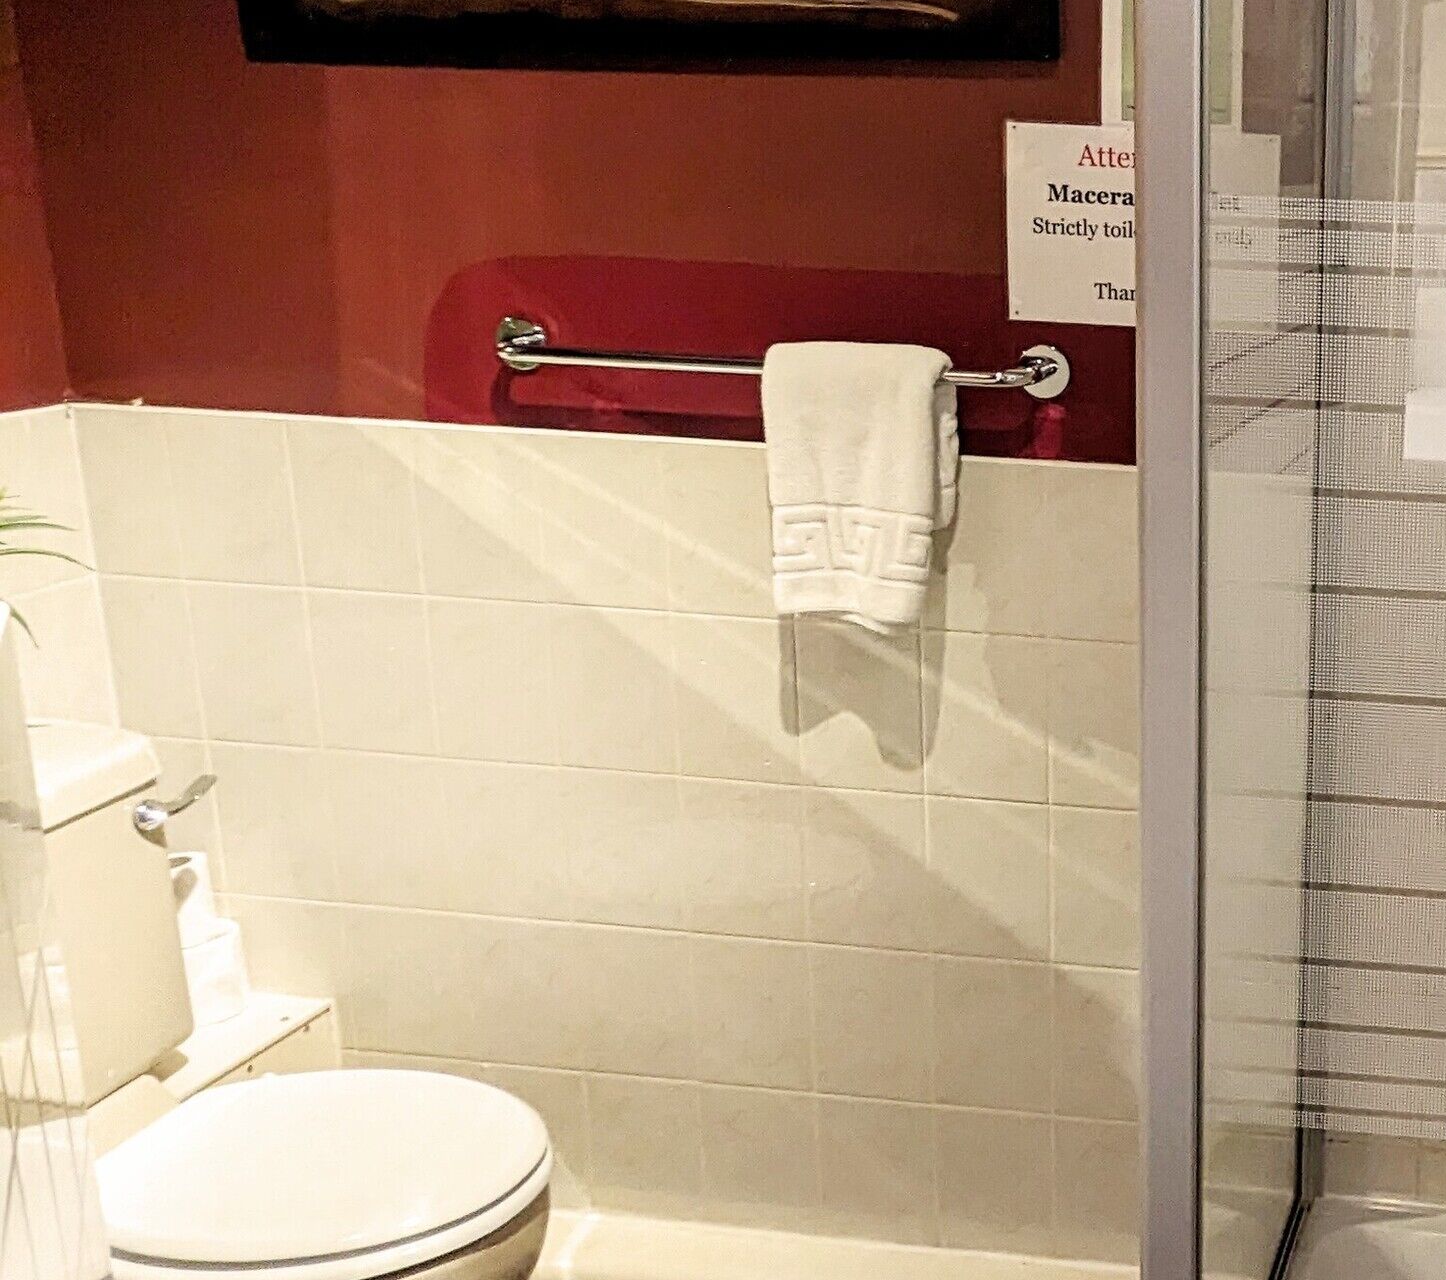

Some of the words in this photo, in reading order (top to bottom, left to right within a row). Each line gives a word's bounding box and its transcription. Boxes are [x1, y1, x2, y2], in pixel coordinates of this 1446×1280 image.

[1078, 144, 1136, 169] Atte
[1032, 217, 1099, 241] Strictly
[1103, 220, 1136, 239] toil
